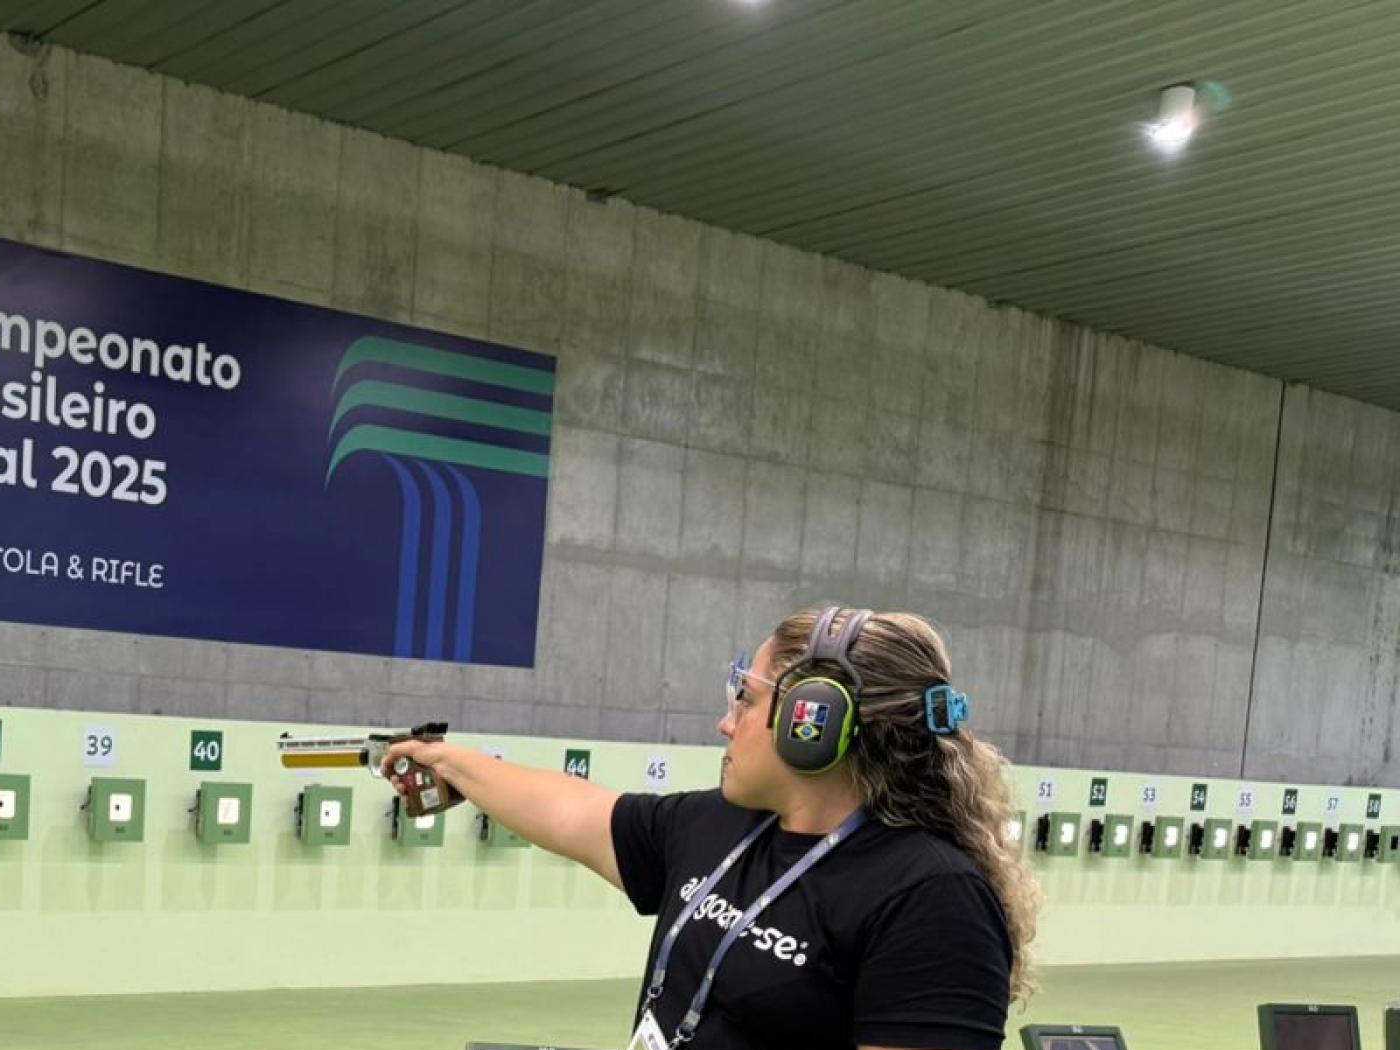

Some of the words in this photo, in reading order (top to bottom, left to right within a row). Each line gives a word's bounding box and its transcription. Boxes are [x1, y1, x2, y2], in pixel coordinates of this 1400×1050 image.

[50, 446, 168, 505] 2025
[67, 555, 85, 580] &
[91, 557, 164, 589] RIFLE
[86, 735, 113, 757] 39
[193, 741, 220, 762] 40
[566, 757, 587, 777] 44
[647, 761, 667, 780] 45
[1039, 781, 1053, 798] 51
